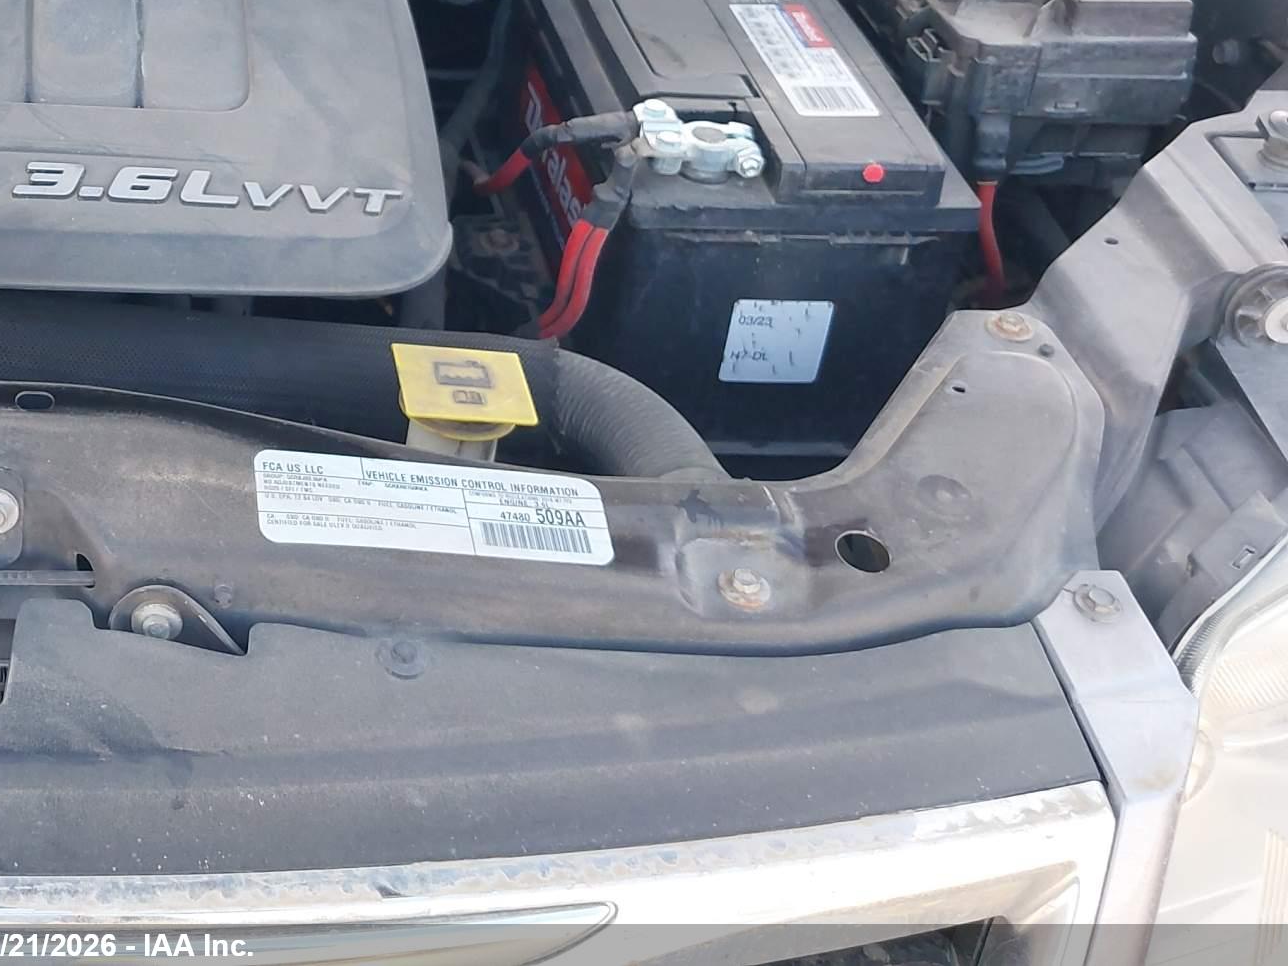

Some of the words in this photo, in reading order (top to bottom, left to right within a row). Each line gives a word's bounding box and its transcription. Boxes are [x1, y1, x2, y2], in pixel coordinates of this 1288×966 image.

[10, 160, 240, 209] 3.6L
[242, 180, 404, 217] VVT
[262, 461, 283, 471] FCA
[286, 462, 301, 473] US
[304, 464, 324, 475] LLC
[365, 469, 406, 482] VEHICLE
[410, 474, 458, 487] EMISSION
[461, 478, 507, 491] CONTROL
[510, 483, 579, 497] INFORMATION
[535, 508, 586, 527] 509AA
